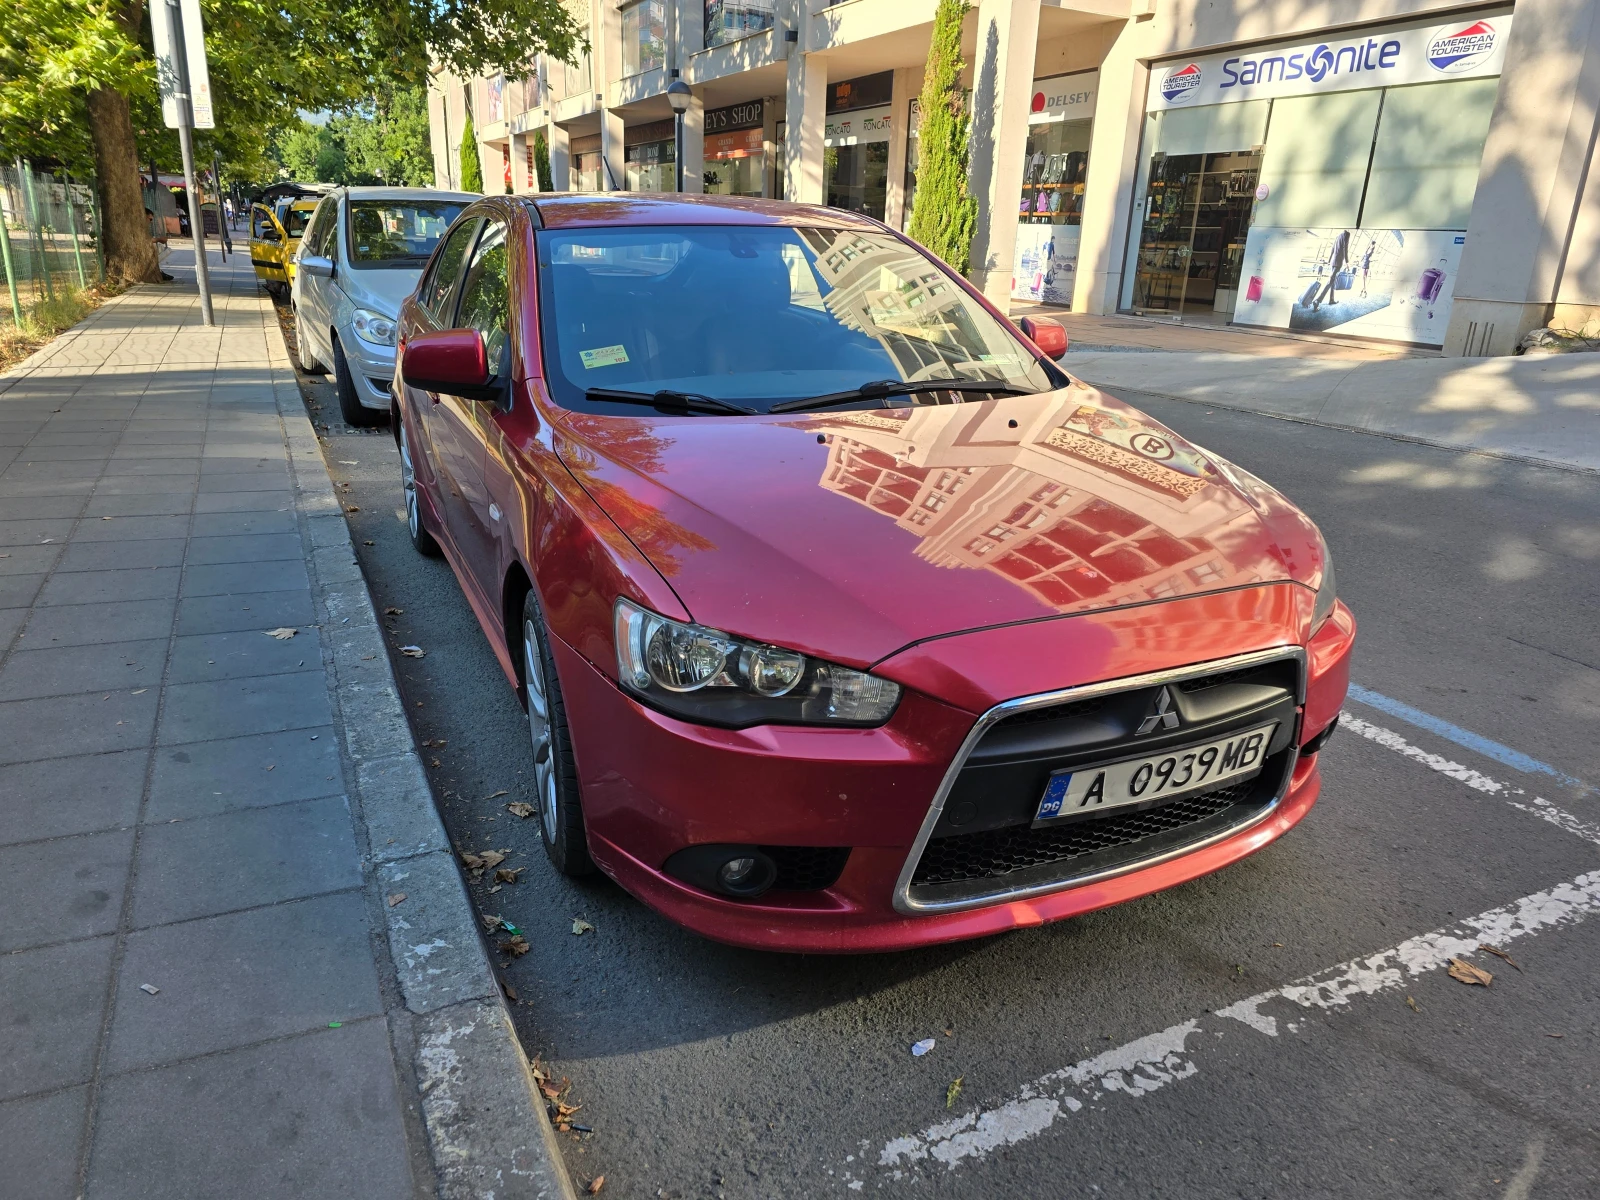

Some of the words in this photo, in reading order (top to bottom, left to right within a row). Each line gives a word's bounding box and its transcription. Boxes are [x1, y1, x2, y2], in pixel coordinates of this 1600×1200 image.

[1431, 34, 1495, 49] AMERICAN
[1430, 43, 1493, 56] TOURISTER
[1220, 39, 1401, 88] Samsonite
[1162, 80, 1201, 91] TOURISTER
[1163, 73, 1202, 84] AMERICAN
[1047, 92, 1091, 107] DELSEY
[732, 103, 761, 124] SHOP
[1080, 770, 1106, 807] A
[1129, 747, 1219, 798] 0939
[1216, 736, 1265, 776] MB
